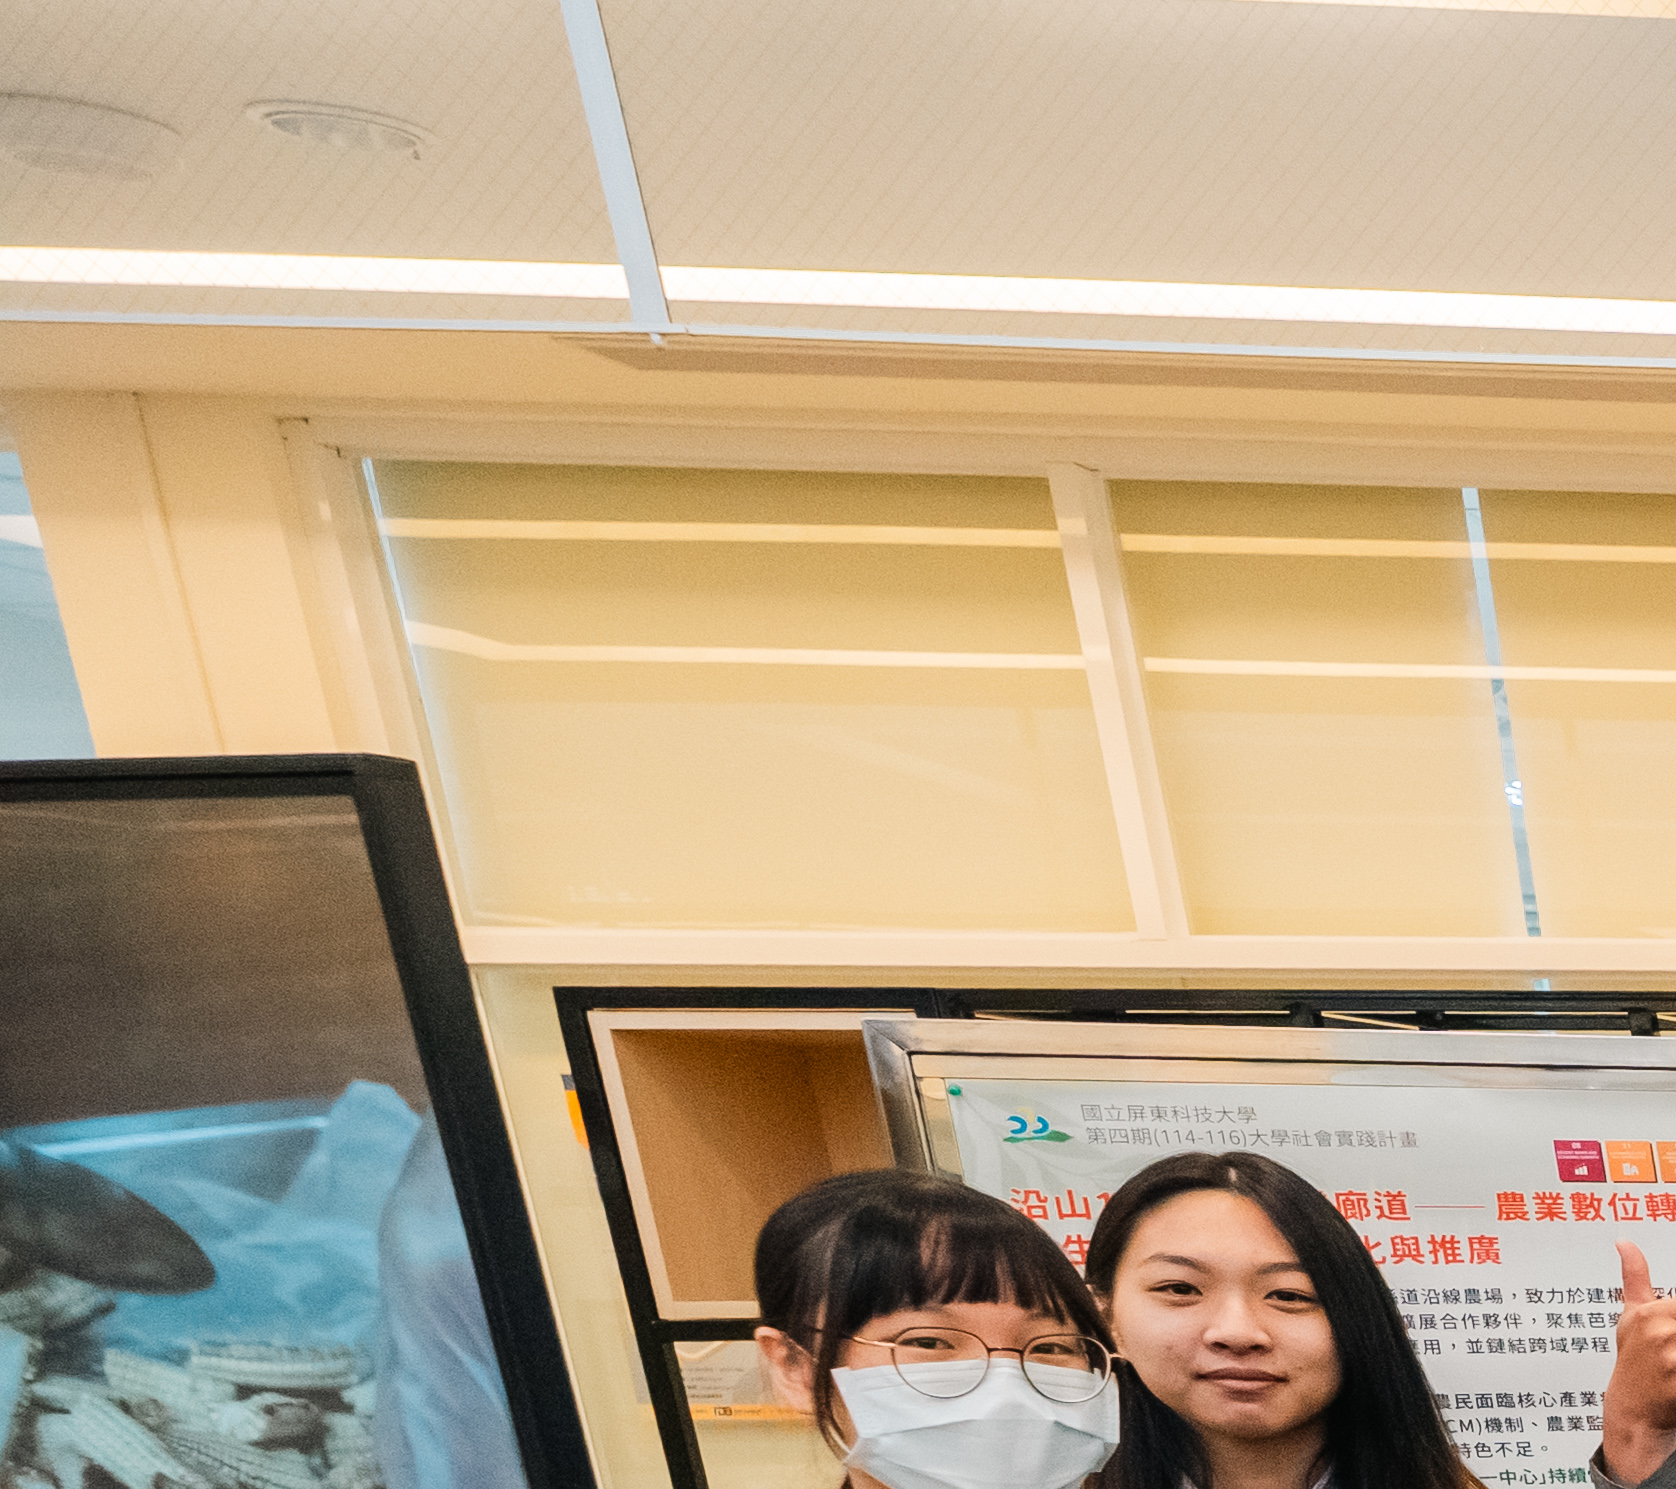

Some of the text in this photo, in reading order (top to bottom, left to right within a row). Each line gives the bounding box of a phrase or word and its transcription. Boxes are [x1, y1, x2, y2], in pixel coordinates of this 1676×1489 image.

[1080, 1103, 1258, 1124] 國立屏東科技大學
[1085, 1126, 1420, 1149] 第四期(114-116)大學社會實踐計畫
[1437, 1391, 1606, 1410] 農民面臨核心產業
